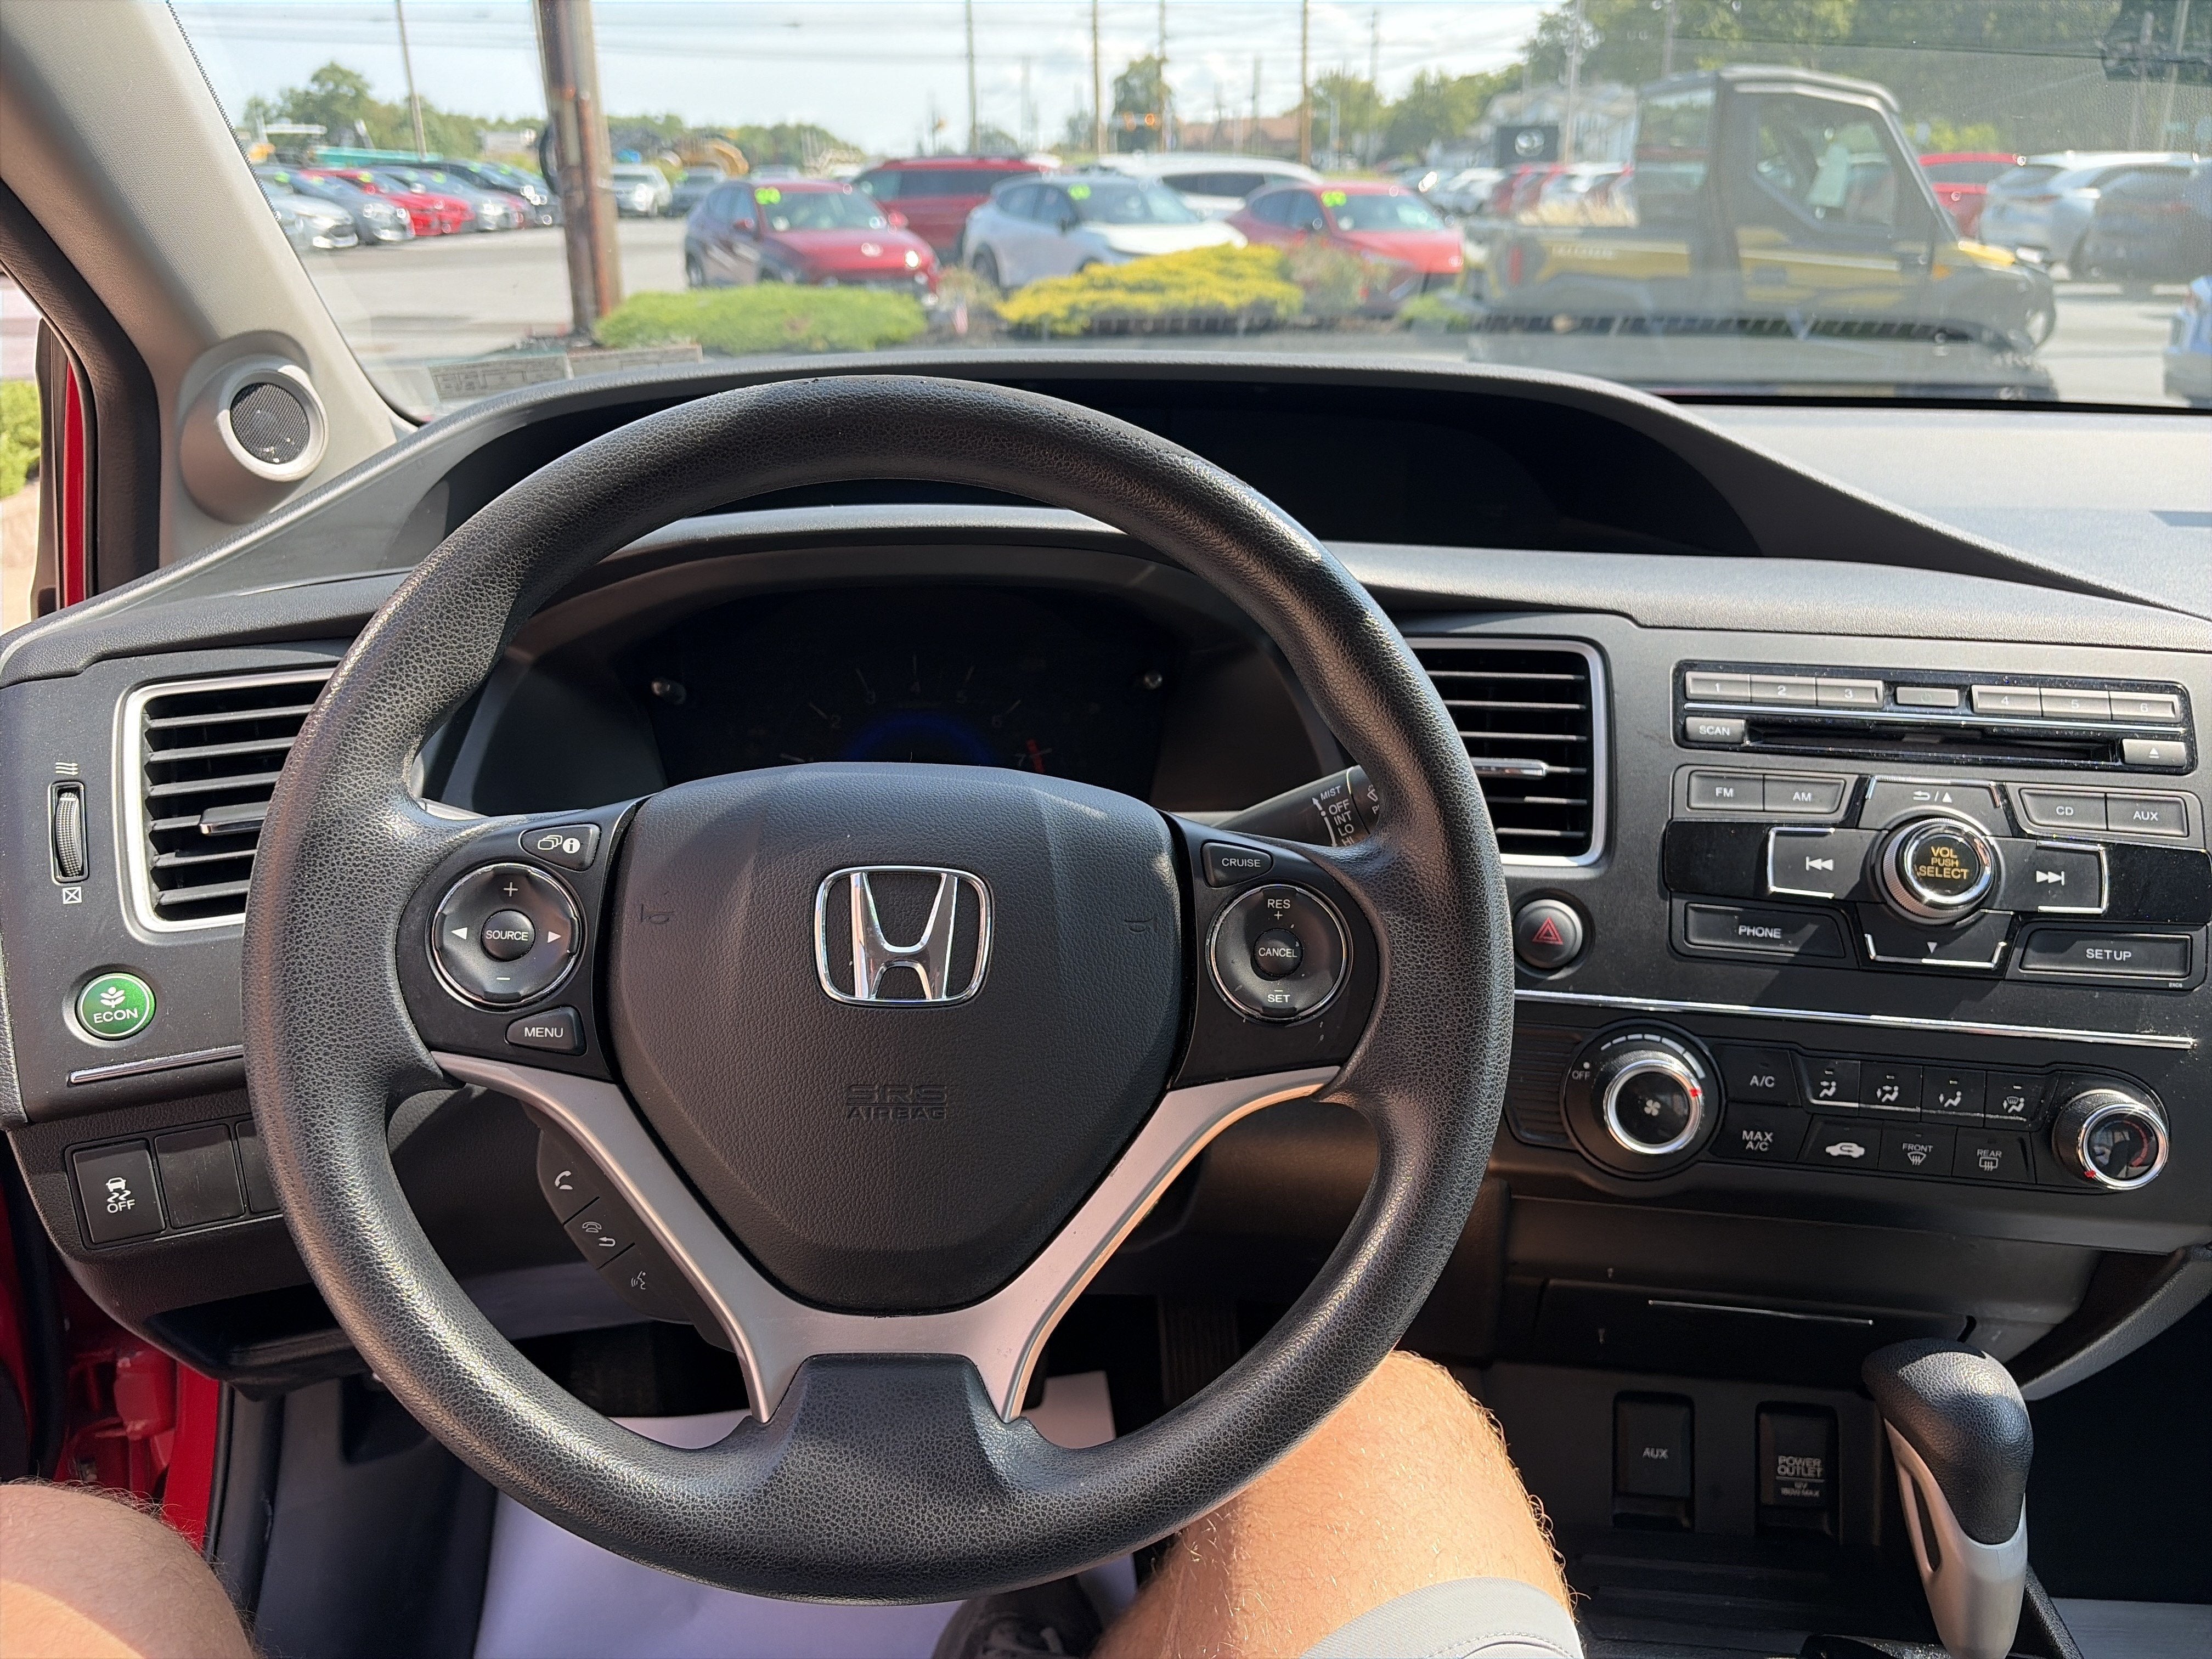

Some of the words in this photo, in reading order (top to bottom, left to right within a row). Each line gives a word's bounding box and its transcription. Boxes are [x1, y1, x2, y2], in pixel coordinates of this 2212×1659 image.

[1714, 683, 1720, 693] 1
[1778, 685, 1786, 695] 2
[1844, 689, 1853, 698] 3
[2001, 696, 2010, 706] 4
[2071, 699, 2079, 709] 5
[2140, 703, 2148, 713] 6
[1699, 725, 1730, 736] SCAN
[1320, 786, 1341, 800] MIST
[1716, 787, 1734, 798] FM
[1792, 792, 1812, 802] AM
[1328, 799, 1350, 815] OFF
[2056, 806, 2074, 816] CD
[1334, 810, 1351, 825] INT
[2133, 810, 2158, 821] AUX
[1338, 823, 1354, 837] LO
[1341, 836, 1355, 847] HI
[1931, 847, 1957, 857] VOL
[1221, 857, 1261, 868] CRUISE
[1931, 857, 1959, 867] PUSH
[1919, 866, 1968, 879] SELECT
[1267, 899, 1290, 909] RES
[486, 930, 528, 941] SOURCE
[1738, 926, 1781, 939] PHONE
[1259, 947, 1297, 958] CANCEL
[2086, 949, 2131, 961] SETUP
[1267, 994, 1290, 1003] SET
[93, 1008, 138, 1023] ECON
[524, 1027, 563, 1038] MENU
[1572, 1070, 1590, 1080] OFF
[1750, 1075, 1775, 1087] A/C
[846, 1085, 947, 1104] SRS
[847, 1107, 947, 1119] AIRBAG
[1742, 1130, 1773, 1143] MAX
[1745, 1141, 1769, 1152] A/C
[1903, 1143, 1933, 1153] FRONT
[1977, 1149, 2002, 1158] REAR
[107, 1200, 135, 1214] OFF
[1642, 1447, 1668, 1459] AUX
[1778, 1455, 1821, 1466] POWER
[1777, 1465, 1823, 1478] OUTLET
